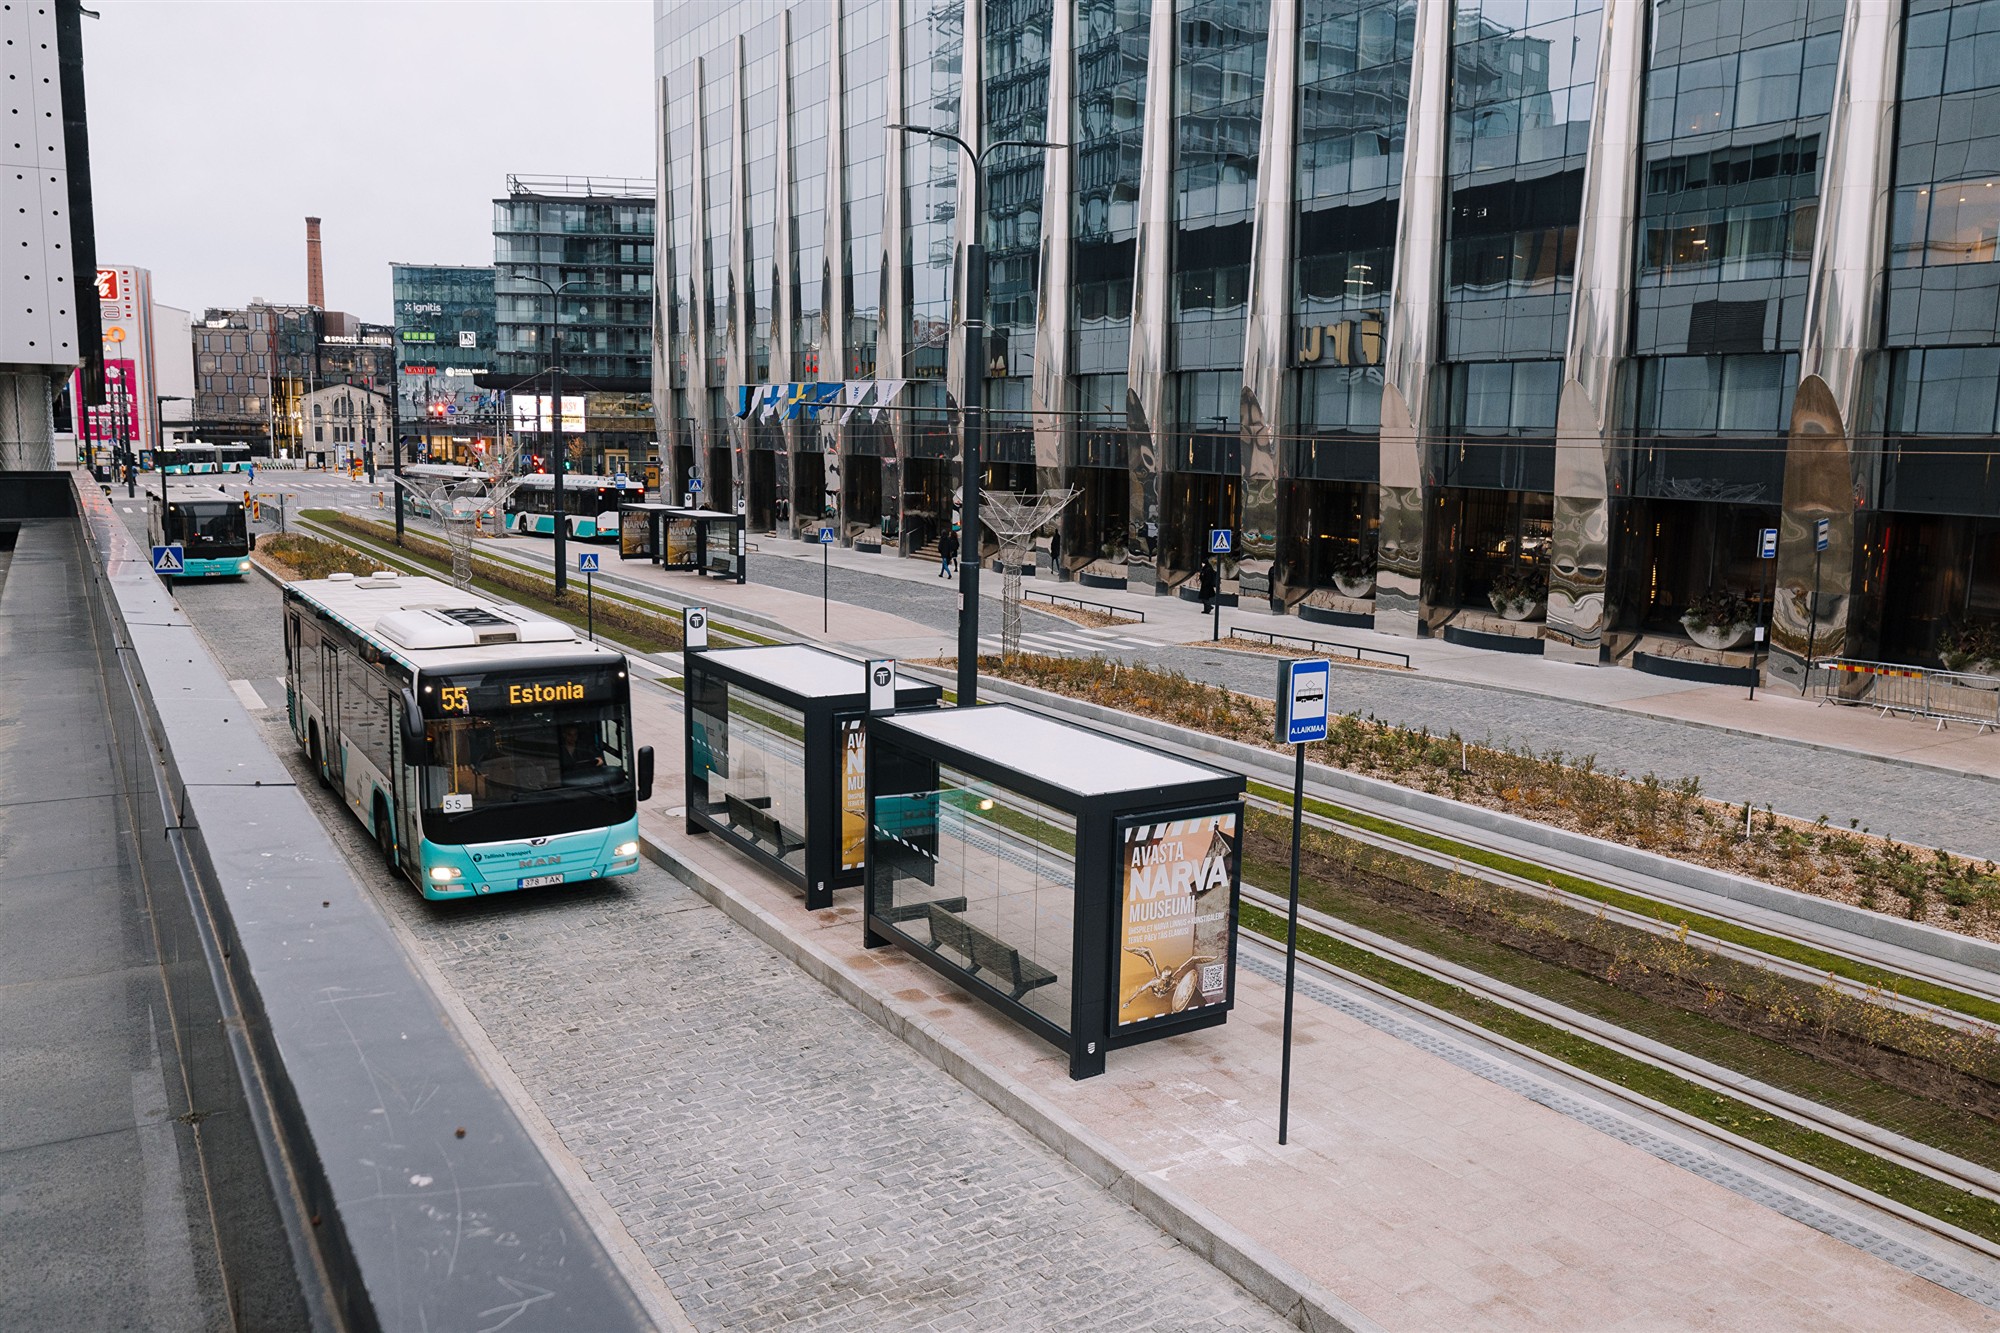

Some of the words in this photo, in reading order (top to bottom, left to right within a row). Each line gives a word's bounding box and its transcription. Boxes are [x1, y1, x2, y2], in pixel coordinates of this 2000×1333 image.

[413, 302, 441, 314] ignitis
[669, 527, 696, 535] NARVA
[441, 687, 467, 711] 55
[510, 682, 584, 704] Estonia
[484, 852, 505, 860] Tallinna
[506, 849, 532, 857] Transport
[1132, 842, 1184, 867] AVASTA
[519, 856, 561, 869] MAN
[545, 875, 562, 884] TAK
[1130, 855, 1229, 902] NARVA
[1129, 895, 1196, 923] MUUSEUMI
